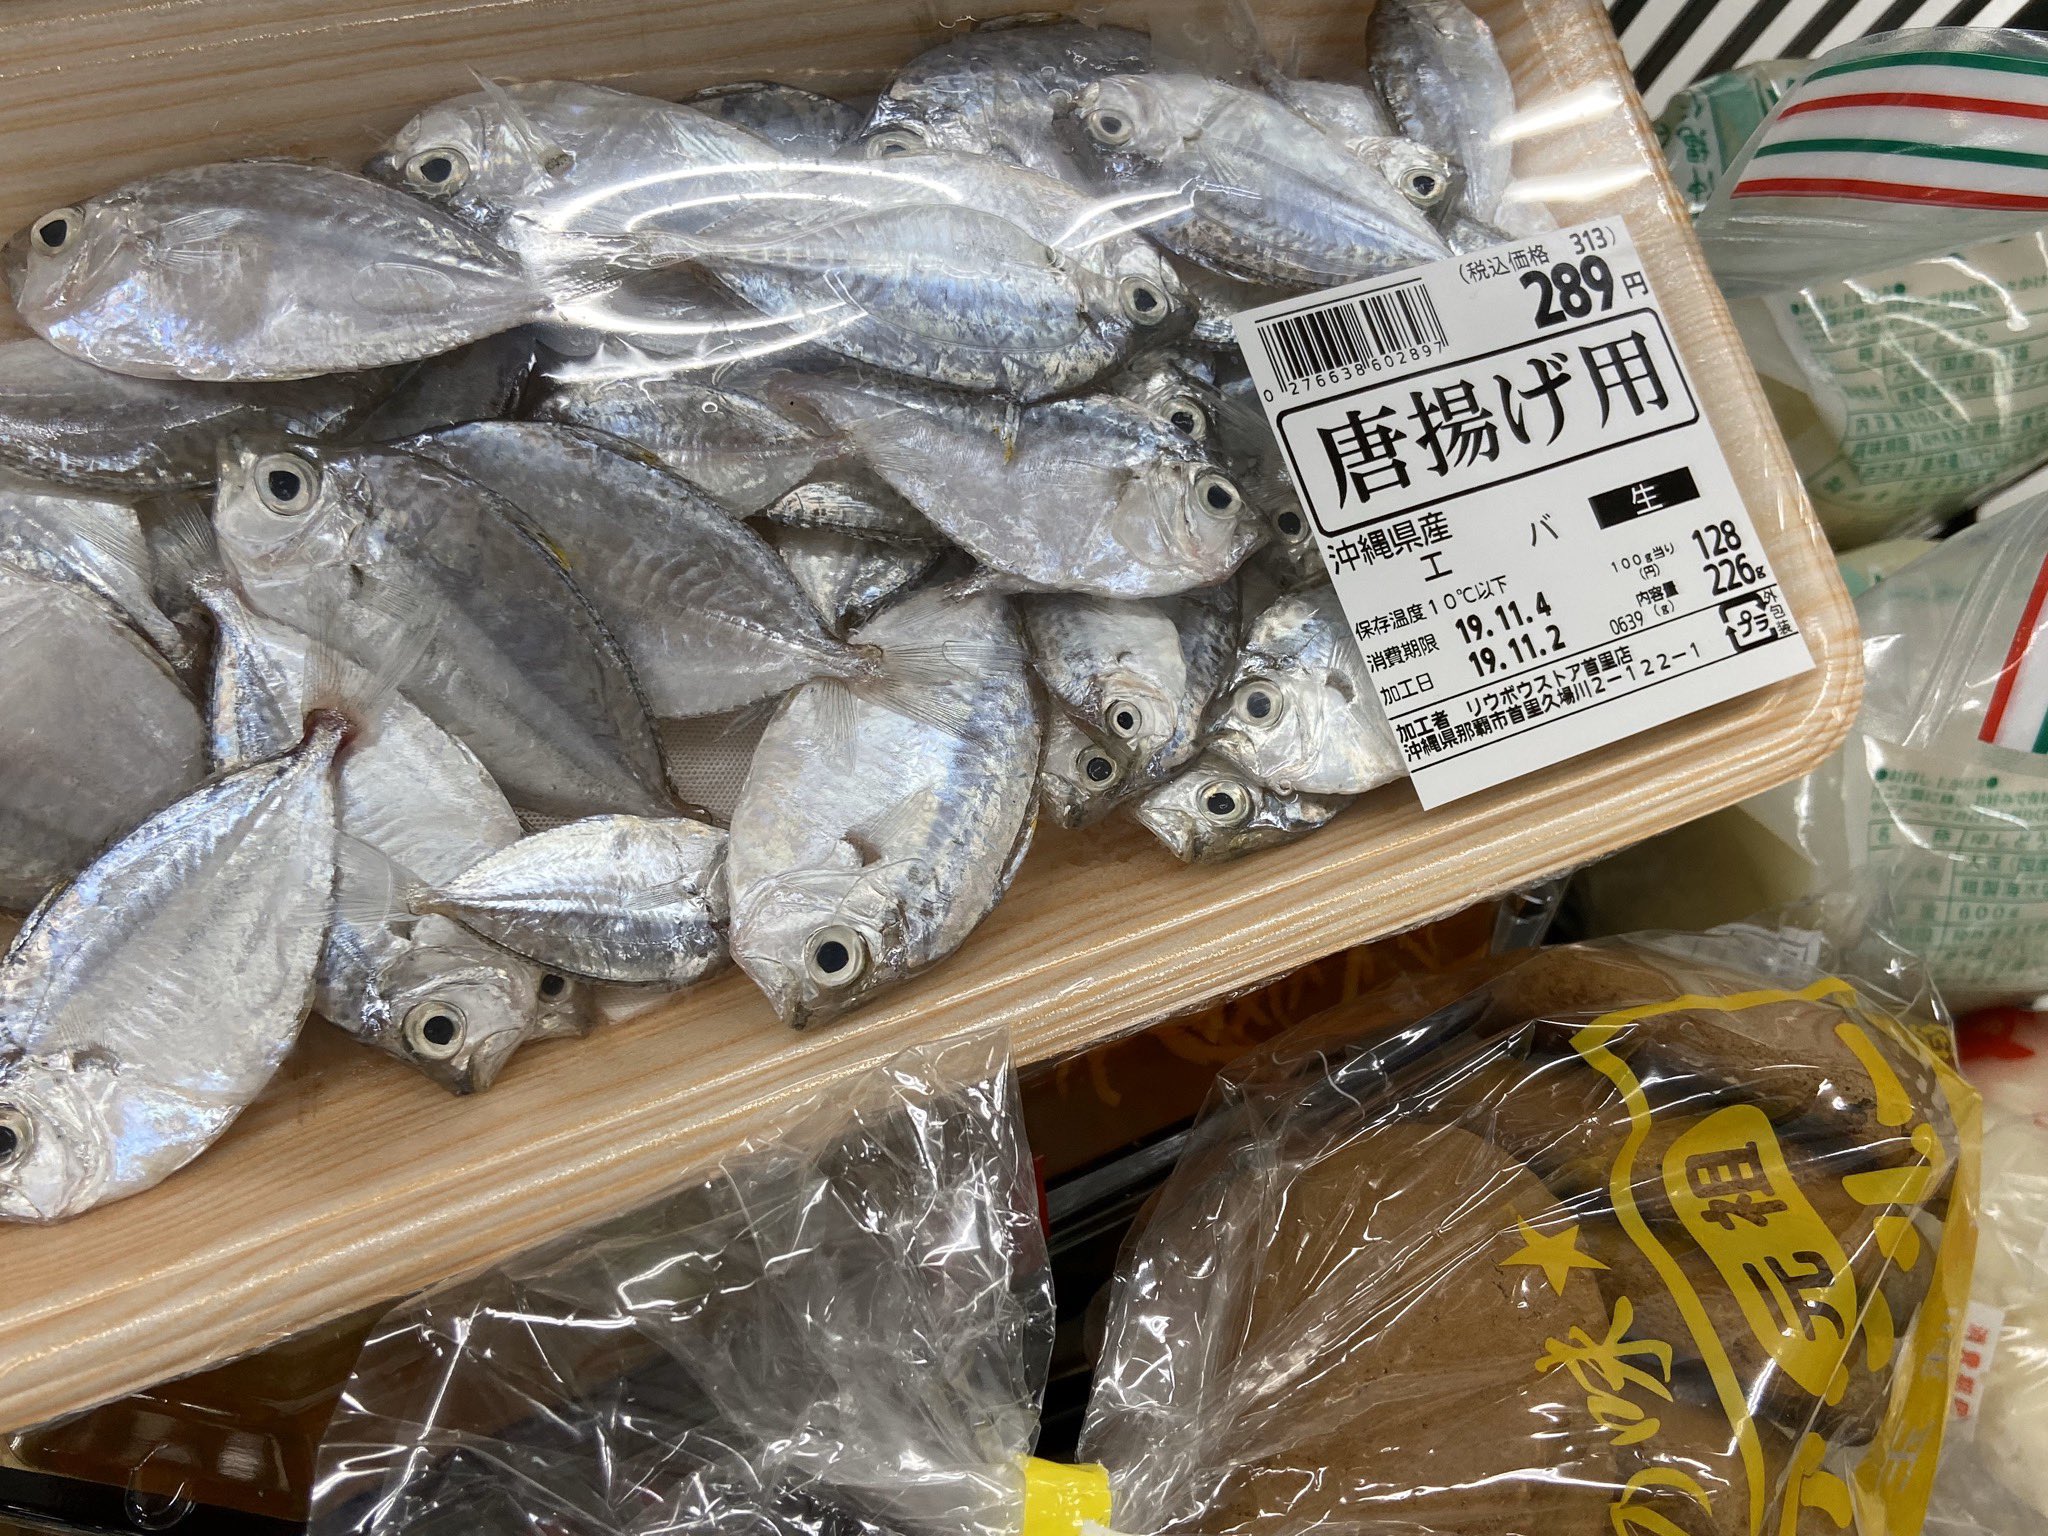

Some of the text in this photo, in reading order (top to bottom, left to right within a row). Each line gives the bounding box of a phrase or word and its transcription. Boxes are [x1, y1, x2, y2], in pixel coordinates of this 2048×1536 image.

[1568, 226, 1617, 256] 313)
[1518, 254, 1650, 330] 289 円
[1315, 329, 1669, 511] 唐揚げ用
[1631, 483, 1664, 516] 生
[1326, 510, 1454, 575] 沖縄県産
[1691, 519, 1742, 560] 128
[1702, 553, 1767, 597] 226g
[1366, 591, 1552, 674] 消費期限 19.11.4
[1608, 610, 1645, 636] 0639
[1736, 609, 1770, 638] プラ
[1762, 588, 1794, 636] 外包装
[1379, 624, 1567, 707] 加工日 19.11.2
[1395, 645, 1634, 744] 加工者 リウボウストア首里店
